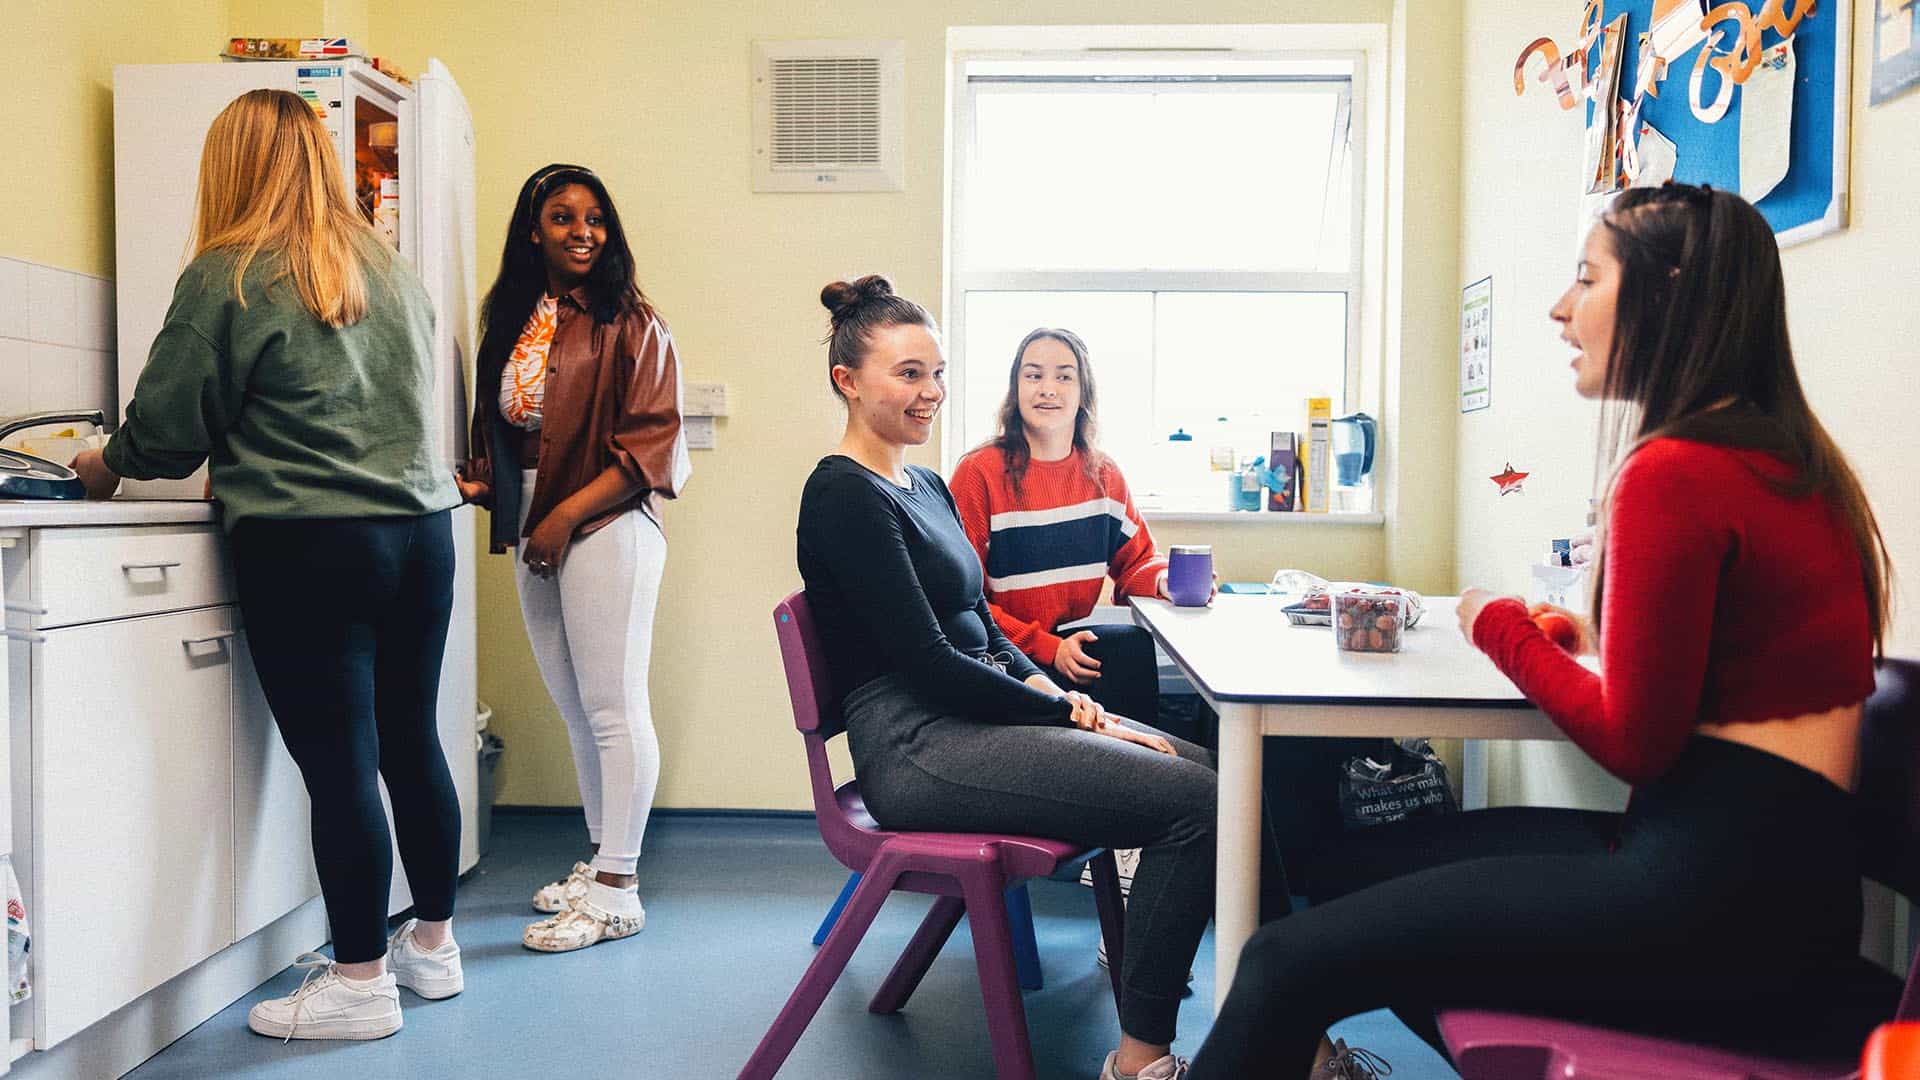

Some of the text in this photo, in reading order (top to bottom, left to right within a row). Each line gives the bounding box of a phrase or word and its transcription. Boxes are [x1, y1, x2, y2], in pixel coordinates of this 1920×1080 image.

[1357, 786, 1393, 800] What
[1399, 782, 1415, 793] we
[1360, 790, 1443, 815] makes us who
